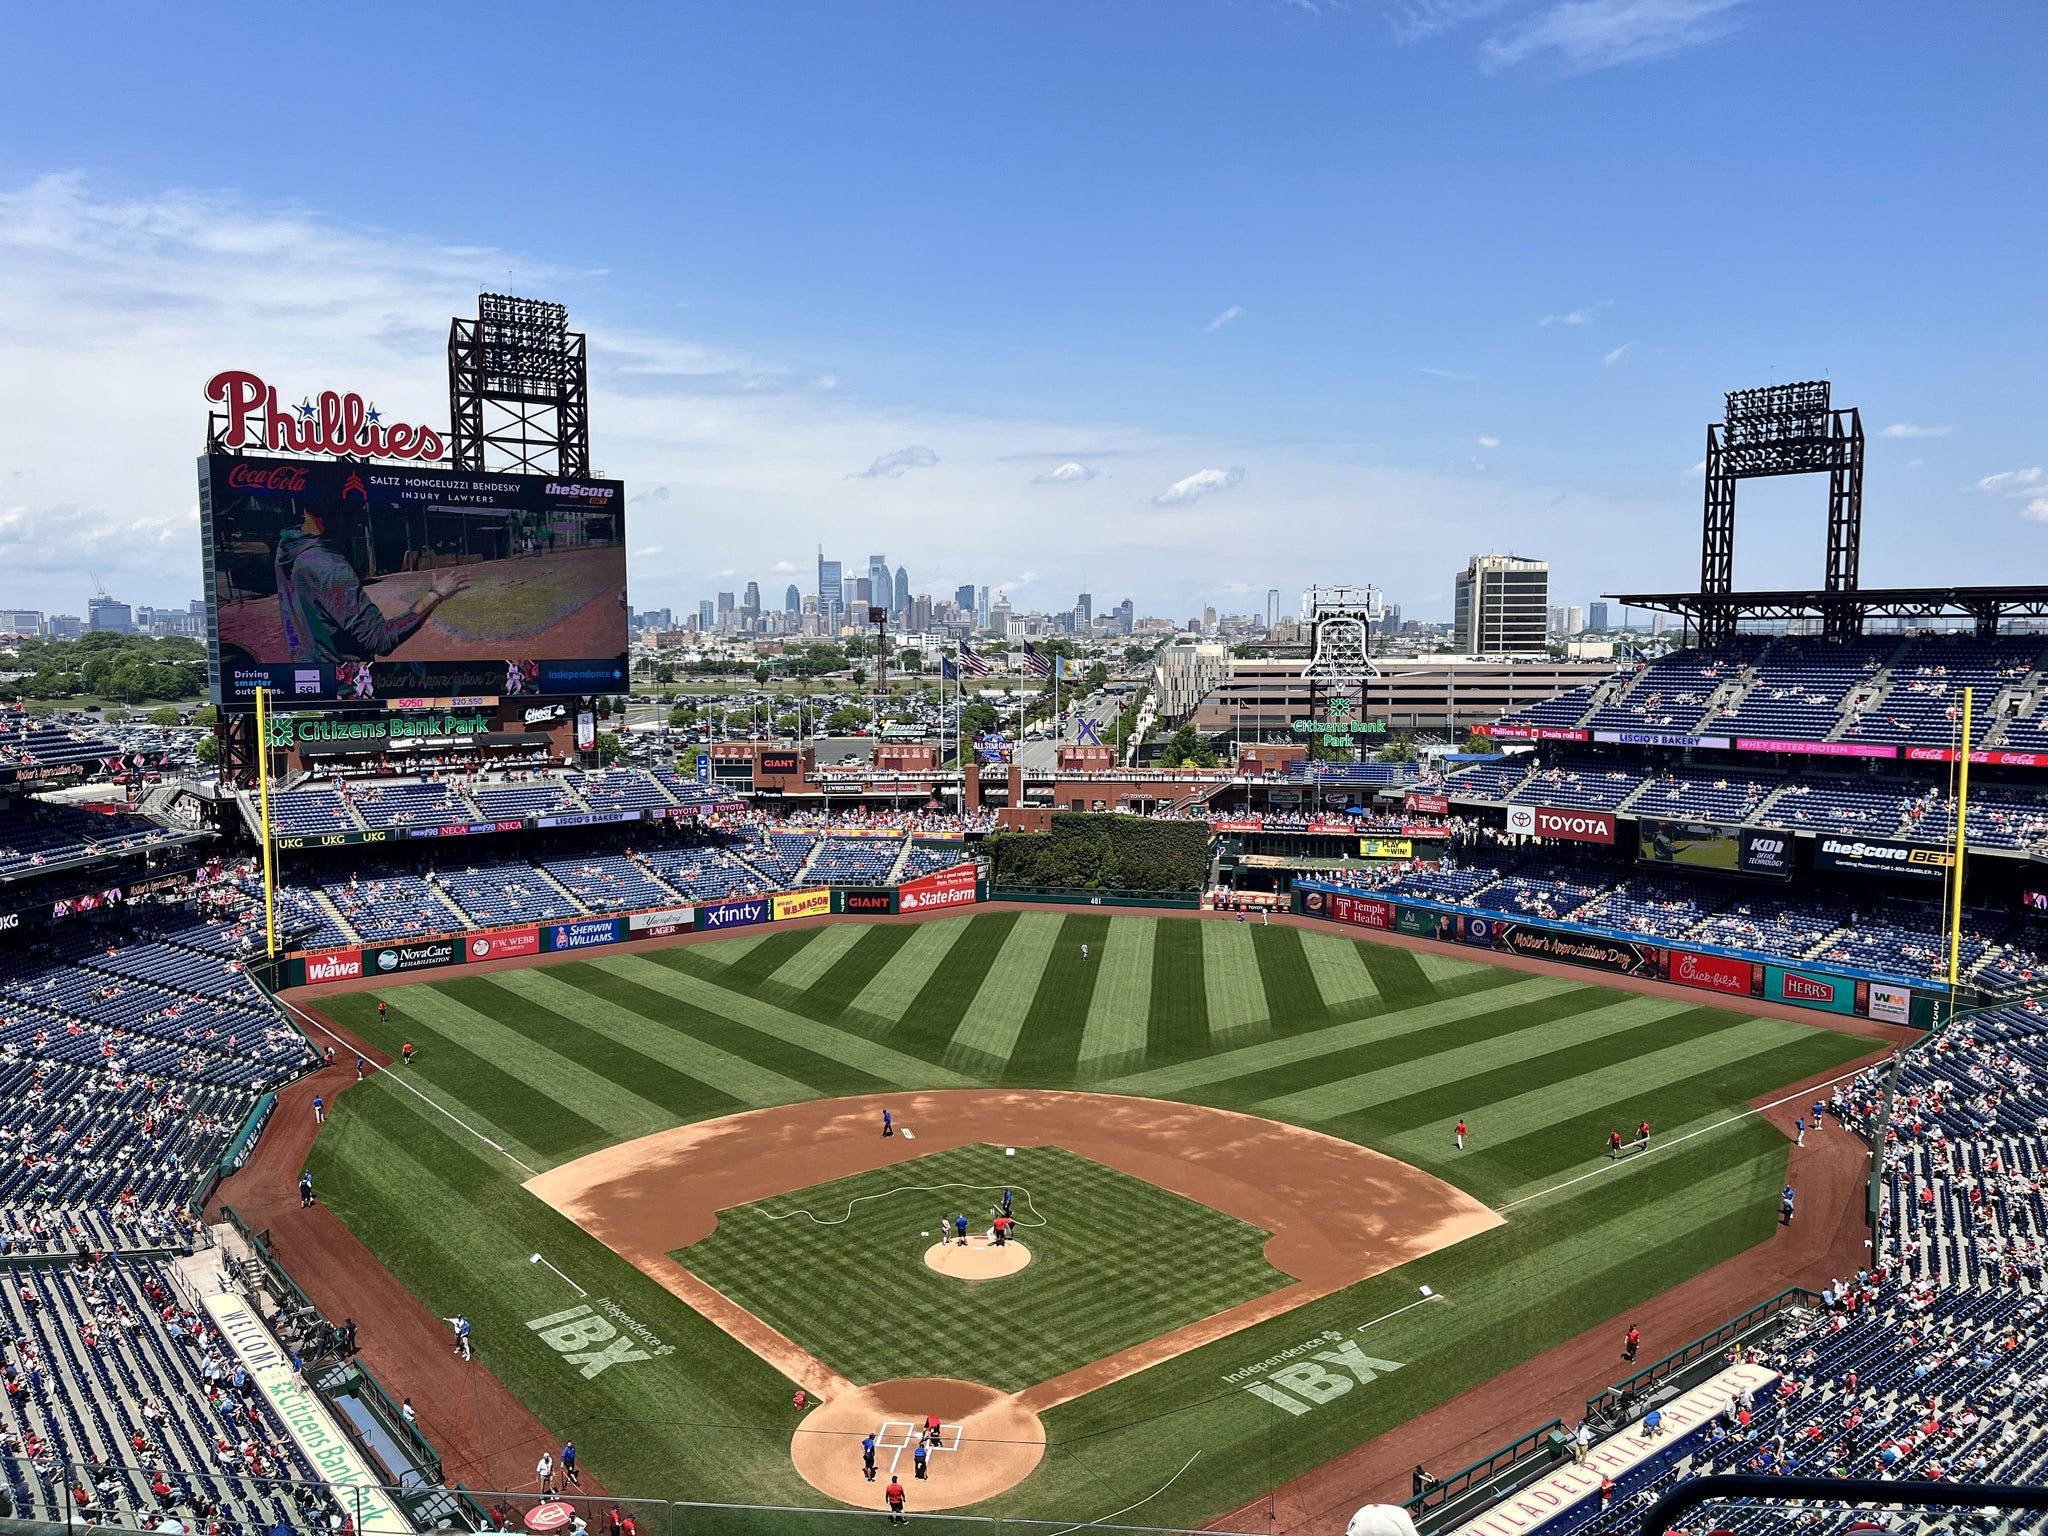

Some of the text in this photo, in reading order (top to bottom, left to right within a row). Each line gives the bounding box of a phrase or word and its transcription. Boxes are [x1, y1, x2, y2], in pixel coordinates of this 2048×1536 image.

[204, 369, 444, 462] Phillies
[228, 463, 309, 492] Coca-Cola
[370, 475, 521, 493] SALTZ MONGELUZZI BENDESKY
[545, 482, 614, 498] theScore
[402, 491, 495, 503] INJURY LAWYERS
[234, 670, 269, 680] Driving
[548, 670, 611, 680] Independence
[234, 679, 272, 688] smarter
[235, 687, 285, 696] outces.
[524, 703, 558, 725] GHOST
[298, 714, 489, 741] Citizens Bank Park
[1292, 719, 1386, 733] Citizens Bank
[1490, 727, 1528, 737] Phillies win
[1323, 733, 1355, 747] Park
[1542, 730, 1559, 738] Deals
[1560, 731, 1574, 739] roll
[1620, 733, 1700, 746] LISCIO'S BAKERY
[1740, 740, 1768, 750] WHEY
[1770, 742, 1804, 752] BETTER
[1806, 744, 1848, 754] PROTEIN
[1911, 748, 1944, 760] Coca-Cola
[2001, 752, 2035, 765] Coca-Cola
[39, 765, 72, 778] Appreciation
[71, 763, 84, 775] Day
[764, 760, 795, 768] GIANT
[667, 807, 699, 816] TOYOTA
[715, 802, 745, 812] TOYOTA
[499, 820, 522, 830] NECA
[555, 813, 625, 825] LISCIO'S BAKERY
[1538, 814, 1608, 836] TOYOTA
[363, 831, 386, 842] UKG
[440, 825, 466, 835] NECA
[279, 838, 304, 849] UKG
[321, 835, 345, 846] UKG
[1756, 852, 1776, 861] OFFICE
[1822, 840, 1954, 865] theScore BET
[1748, 858, 1783, 868] TECHNOLOGY
[1835, 859, 1857, 868] Gambling
[1858, 861, 1880, 869] Problem?
[849, 897, 889, 908] GIANT
[1090, 897, 1101, 905] 401
[708, 903, 762, 926] xfinity
[1353, 900, 1385, 916] Temple
[535, 919, 570, 928] ASPLUNDH
[1353, 911, 1384, 927] Health
[449, 929, 486, 938] ASPLUNDH
[492, 924, 529, 933] ASPLUNDH
[570, 922, 612, 936] SHERWIN
[649, 925, 676, 936] LAGER
[355, 940, 396, 950] ASPLUNDH
[403, 934, 442, 944] ASPLUNDH
[510, 934, 535, 946] WEBB
[306, 946, 348, 956] ASPLUNDH
[399, 945, 452, 961] NovaCare
[501, 945, 525, 953] COMPANY
[1514, 932, 1631, 969] Mother's Appreciation Day
[400, 955, 450, 968] REHABILITATION
[309, 960, 361, 980] Wawa
[1679, 955, 1741, 988] Chick-fil-A
[1787, 980, 1828, 998] HERR'S
[1874, 991, 1905, 1006] WM
[1932, 1000, 1940, 1029] 330
[596, 1296, 662, 1347] Independence
[220, 1309, 280, 1372] WELCOME
[525, 1303, 653, 1380] IBX
[1221, 1336, 1324, 1385] Independence
[1242, 1338, 1407, 1416] IBX
[1664, 1371, 1758, 1435] HILLIES
[278, 1392, 390, 1526] Citizens Bank Park
